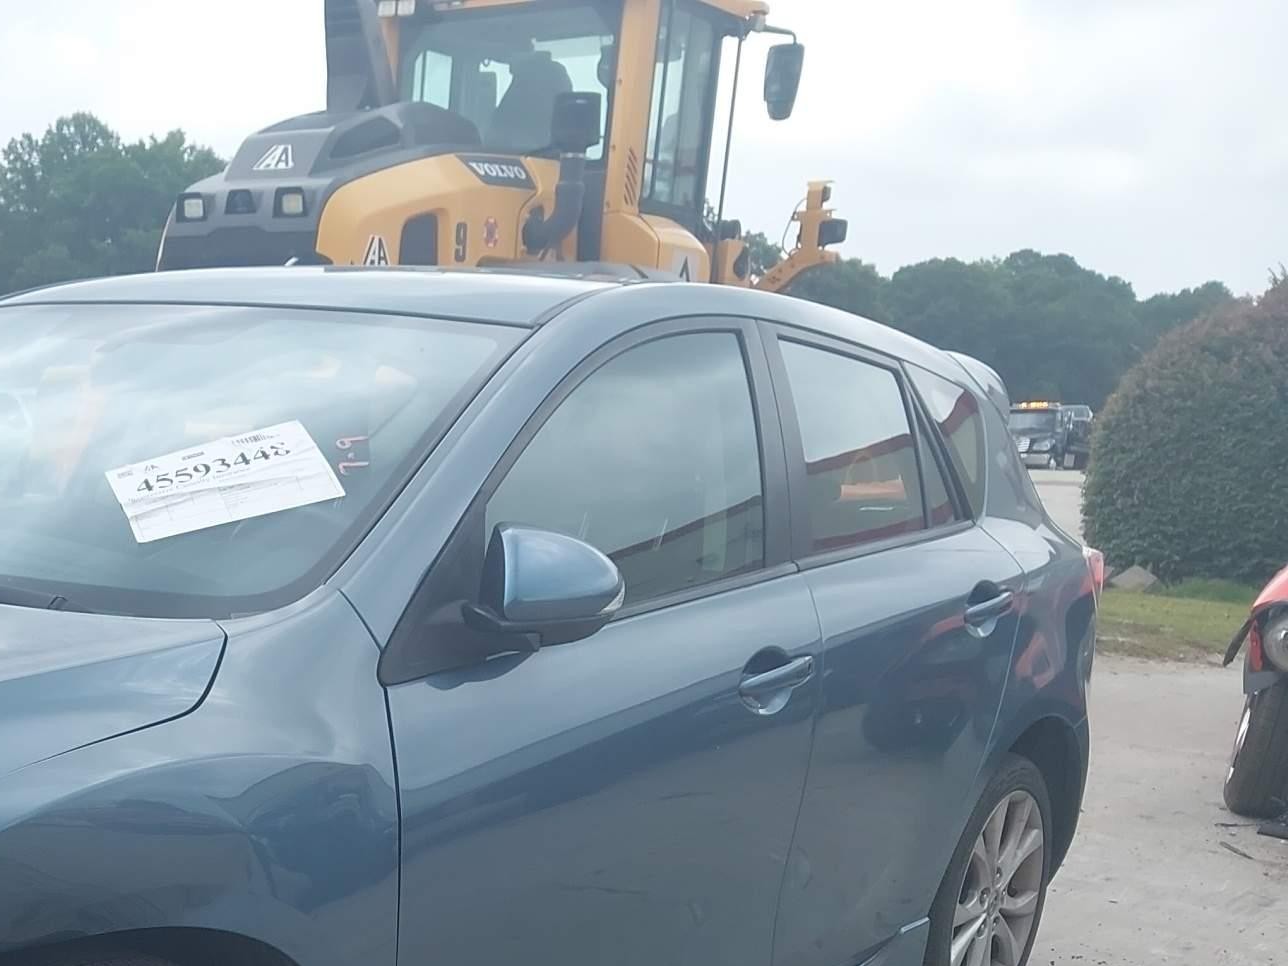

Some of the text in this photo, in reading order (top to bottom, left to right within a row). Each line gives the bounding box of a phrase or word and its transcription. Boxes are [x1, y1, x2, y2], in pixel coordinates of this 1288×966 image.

[468, 162, 526, 179] VOLVO
[454, 222, 468, 262] 9
[137, 442, 291, 493] 45593448
